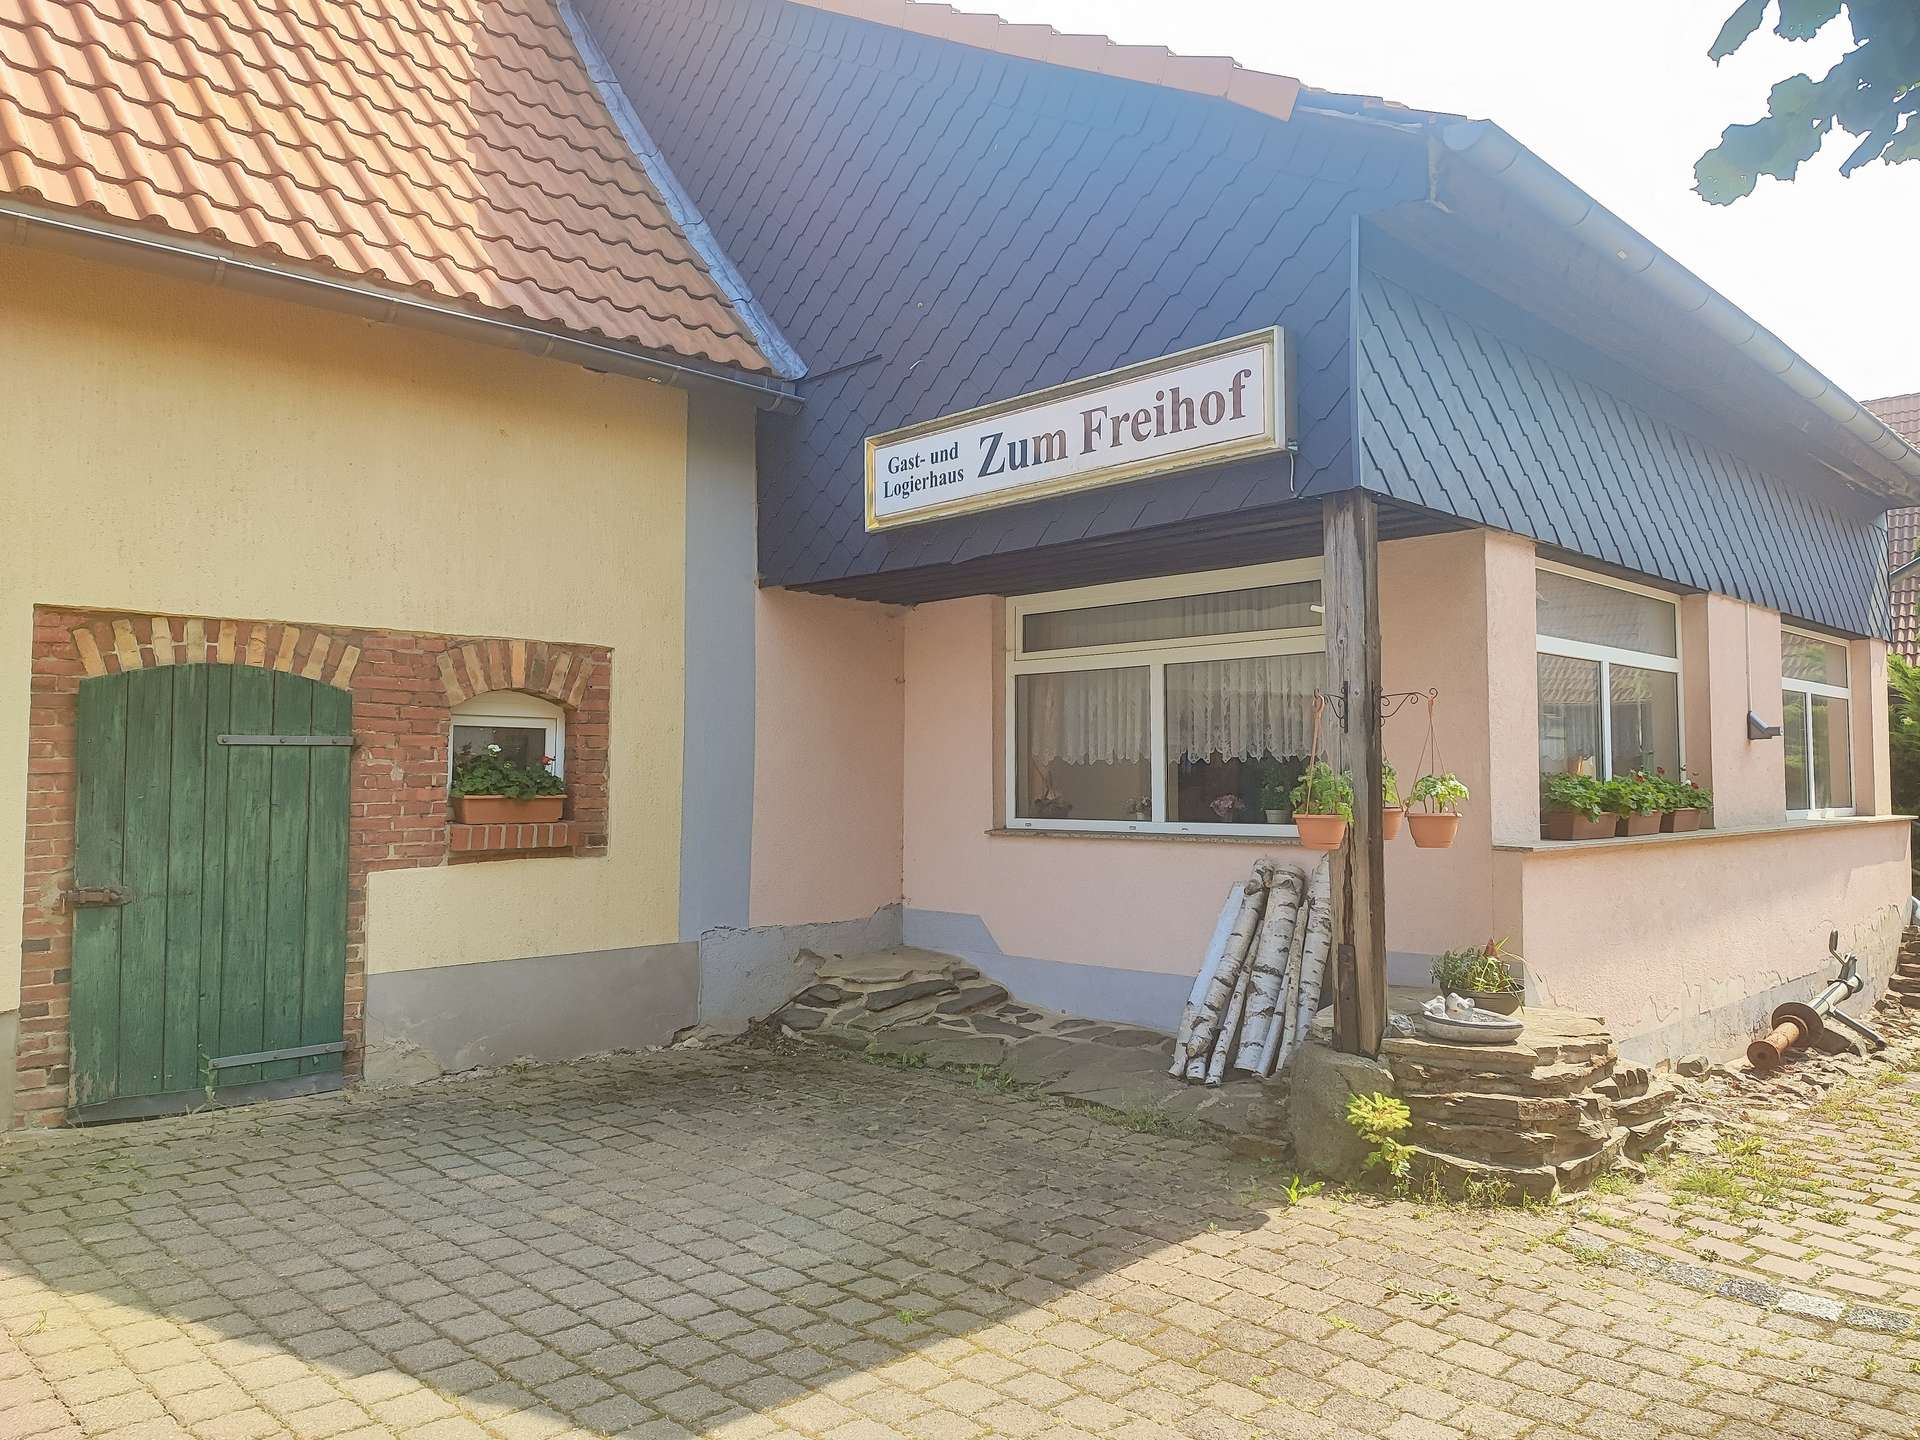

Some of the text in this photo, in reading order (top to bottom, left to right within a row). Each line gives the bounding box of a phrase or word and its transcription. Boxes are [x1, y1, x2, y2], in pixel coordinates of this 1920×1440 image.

[977, 368, 1252, 478] Zum Freihof
[887, 441, 959, 475] Gast- und
[883, 465, 965, 499] Logierhaus
